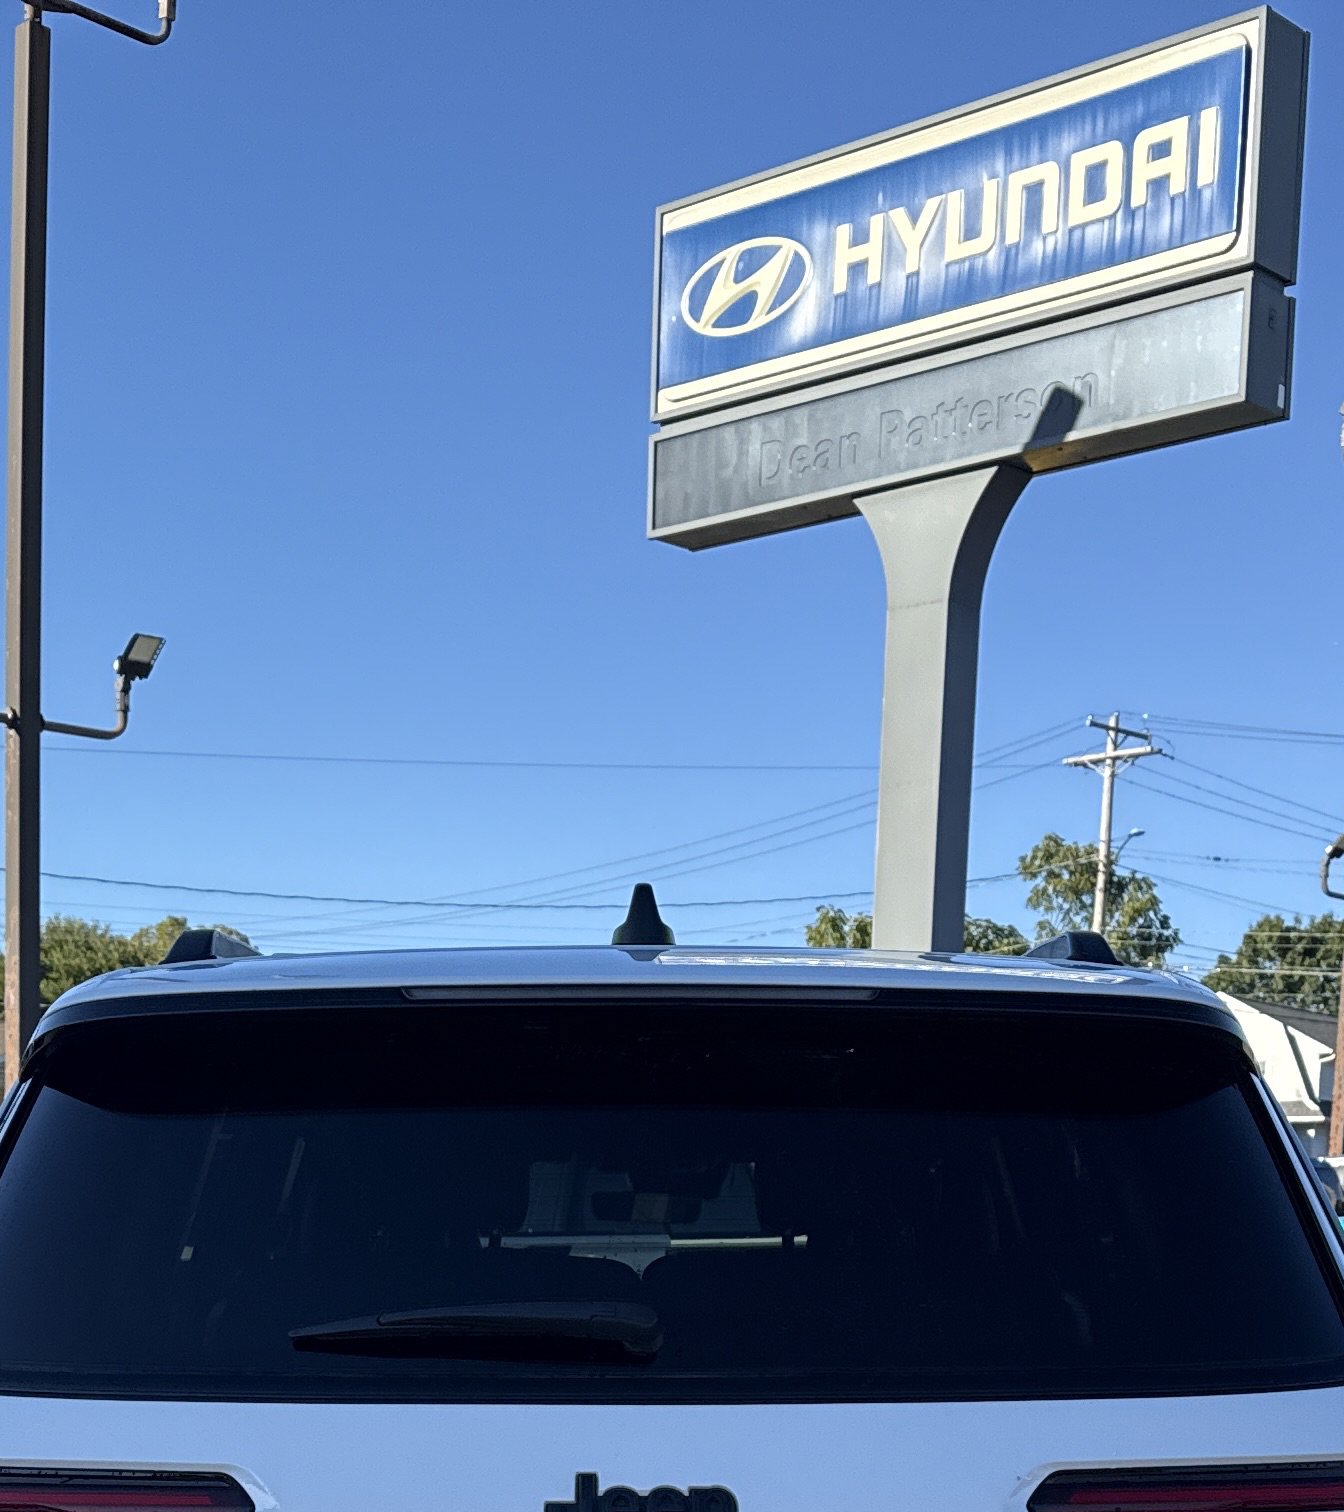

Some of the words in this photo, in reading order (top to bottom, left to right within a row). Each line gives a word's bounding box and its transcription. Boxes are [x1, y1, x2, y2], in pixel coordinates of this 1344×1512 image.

[833, 106, 1221, 295] HYUNDAI
[759, 430, 862, 488] Dean
[877, 371, 1100, 459] Patterson
